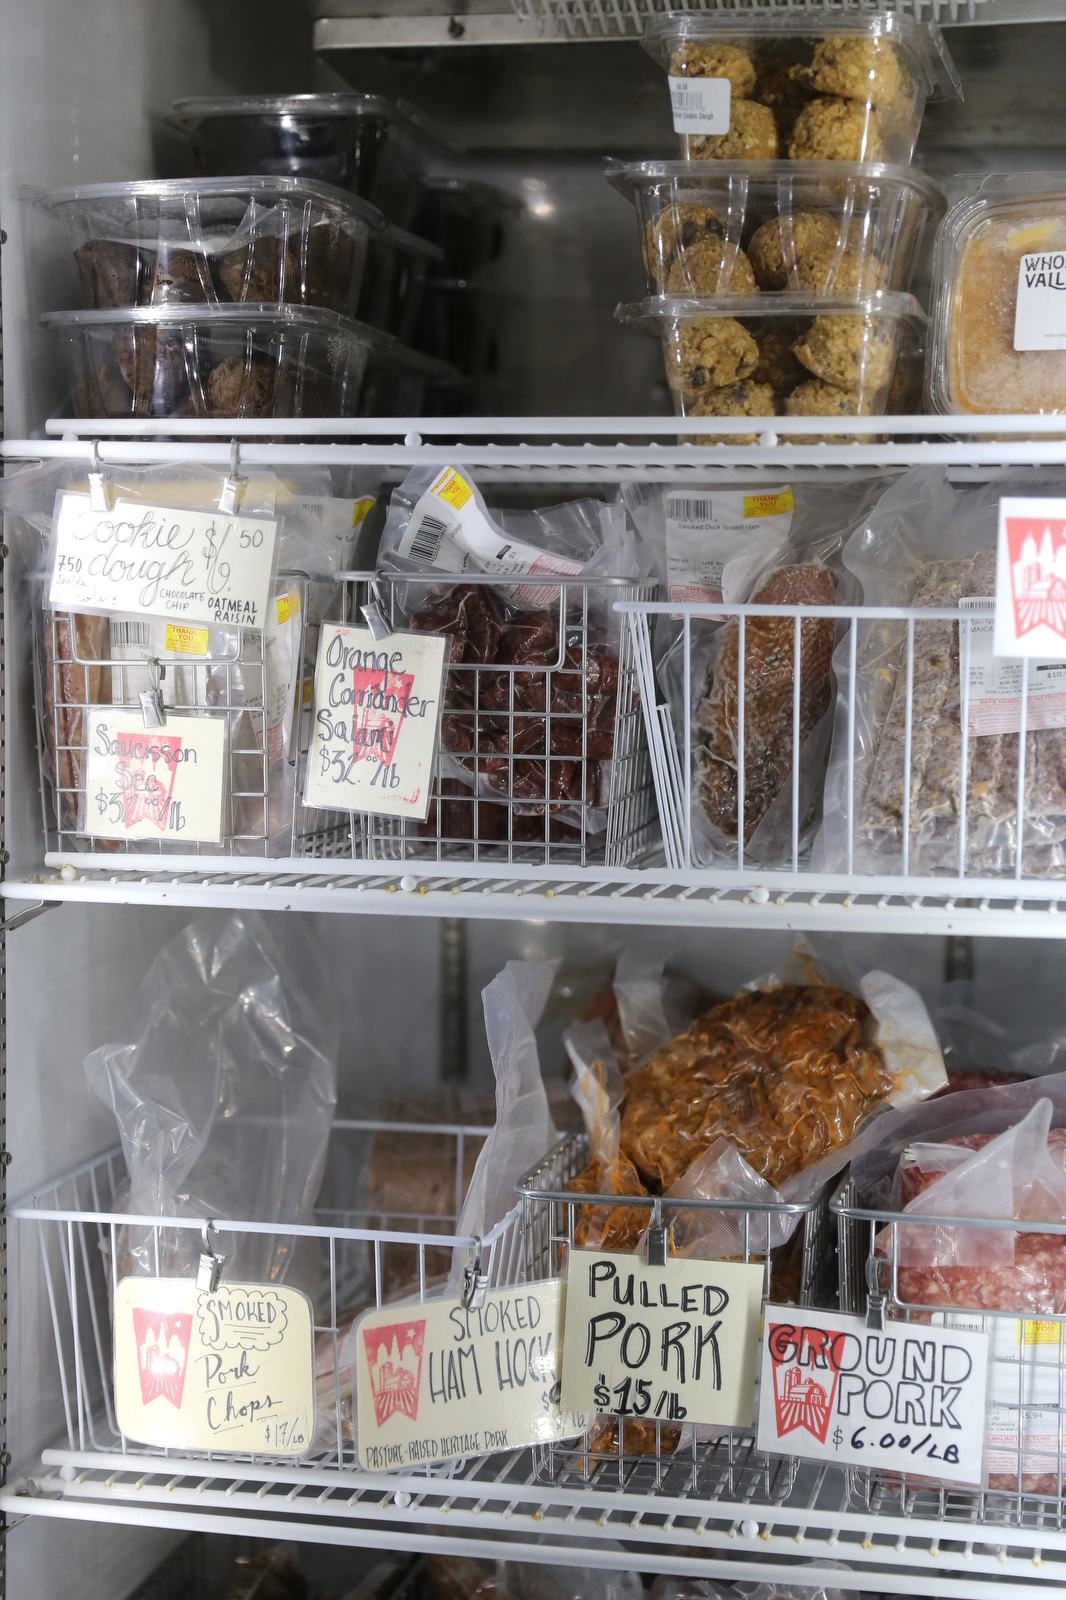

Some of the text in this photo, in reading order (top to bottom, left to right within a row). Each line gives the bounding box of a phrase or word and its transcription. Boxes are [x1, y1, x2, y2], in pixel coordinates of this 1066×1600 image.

[698, 112, 714, 121] Dough
[1024, 255, 1066, 271] WHO
[88, 543, 197, 607] dough
[159, 588, 206, 601] CHOCOLATE
[166, 600, 190, 611] CHIP
[208, 597, 258, 613] OATMEAL
[214, 610, 256, 625] RAISIN
[172, 627, 197, 635] THANK
[961, 626, 994, 634] JMAICA
[326, 634, 407, 692] Orange
[94, 723, 198, 764] Saucisson
[317, 708, 395, 753] Salami
[115, 760, 160, 791] Sec
[589, 1261, 730, 1316] PULLED
[206, 1299, 277, 1342] SMOKED
[449, 1295, 541, 1341] SMOKED
[195, 1350, 260, 1388] Pork
[585, 1312, 723, 1391] PORK
[769, 1323, 973, 1385] GROUND
[429, 1344, 482, 1404] HAM
[206, 1391, 283, 1430] Chops
[594, 1372, 688, 1420] $15/lb
[837, 1373, 963, 1430] PORK
[440, 1432, 481, 1457] HERITAGE
